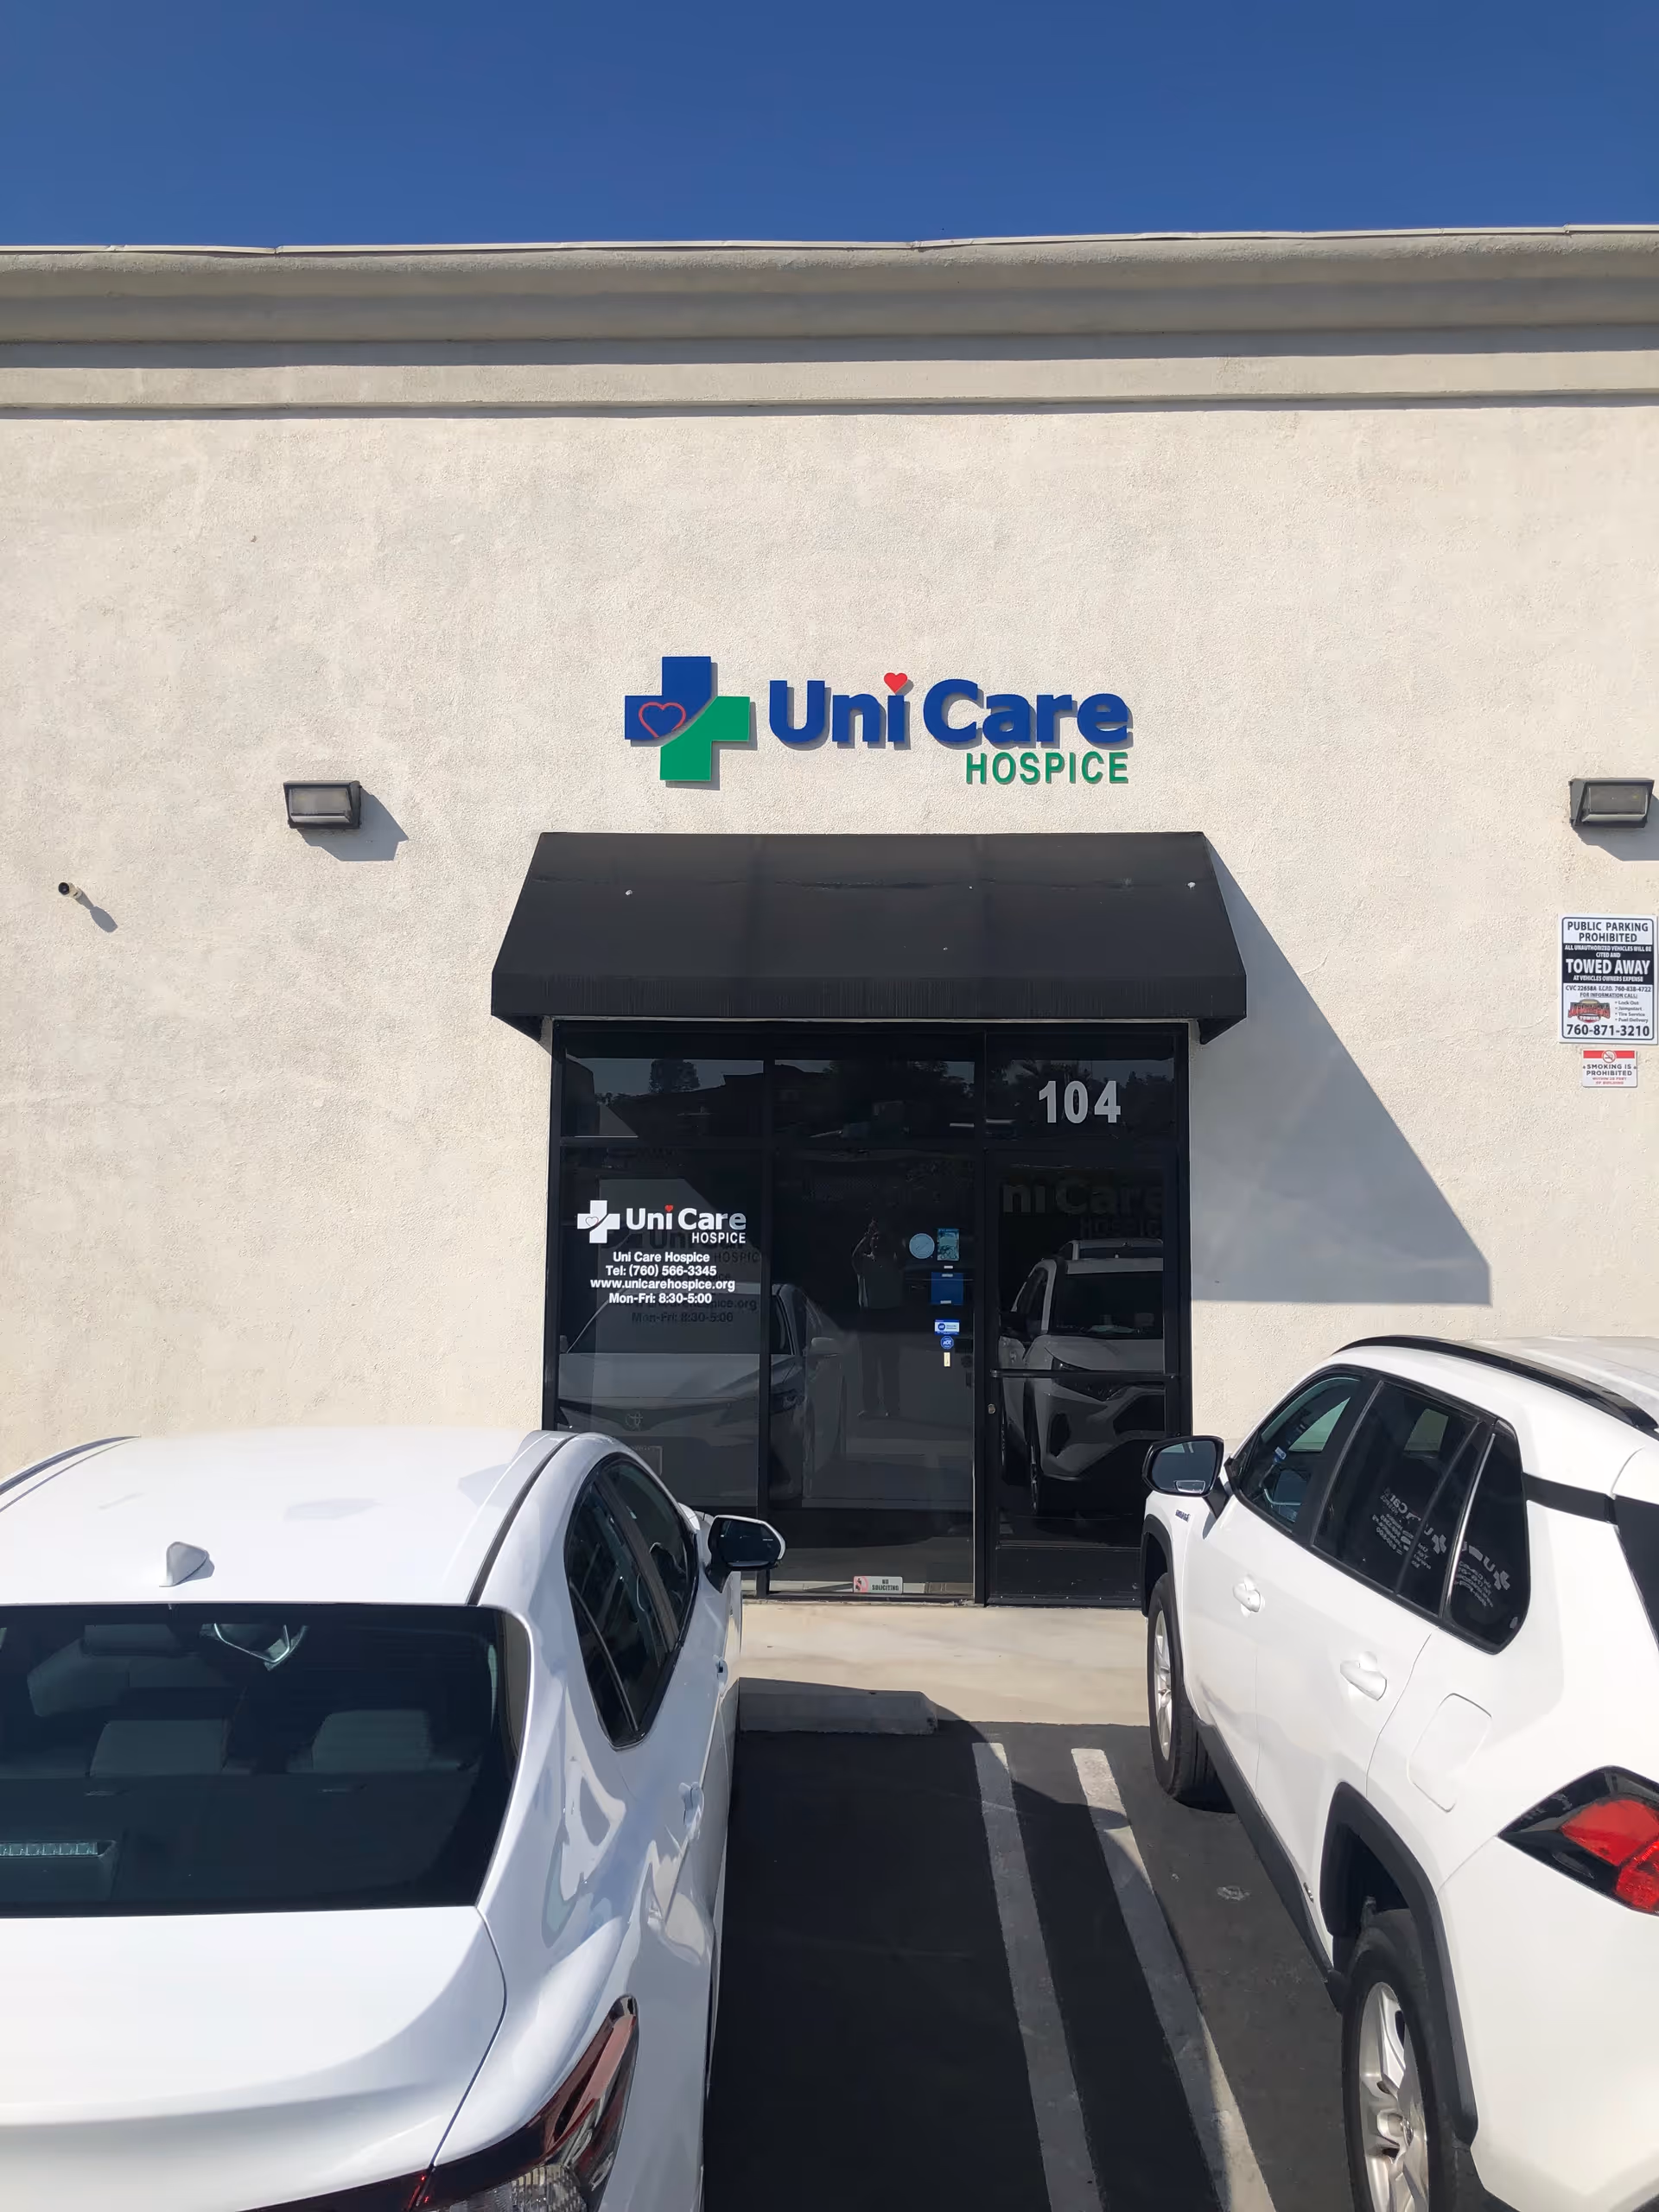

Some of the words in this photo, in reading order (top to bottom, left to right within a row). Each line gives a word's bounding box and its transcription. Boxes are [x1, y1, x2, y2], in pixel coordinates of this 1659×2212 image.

[769, 672, 905, 743] Uni
[923, 678, 1129, 744] Care
[966, 752, 1128, 784] HOSPICE
[1567, 921, 1602, 931] PUBLIC
[1605, 922, 1649, 932] PARKING
[1579, 932, 1637, 943] PROHIBITED
[1565, 958, 1612, 974] TOWED
[1614, 959, 1651, 975] AWAY
[1567, 1024, 1650, 1037] 760-871-3210
[1039, 1080, 1122, 1124] 104
[626, 1205, 673, 1230] Uni
[677, 1207, 747, 1230] Care
[691, 1231, 747, 1244] HOSPICE
[613, 1251, 632, 1262] Uni
[633, 1251, 662, 1262] Care
[664, 1251, 710, 1265] Hospice
[605, 1265, 626, 1276] Tel:
[628, 1264, 659, 1277] (760)
[661, 1265, 717, 1276] 566-3345
[590, 1278, 736, 1293] www.unicarehospice.org
[608, 1293, 656, 1304] Mon-Fri:
[658, 1293, 712, 1304] 8:30-5:00
